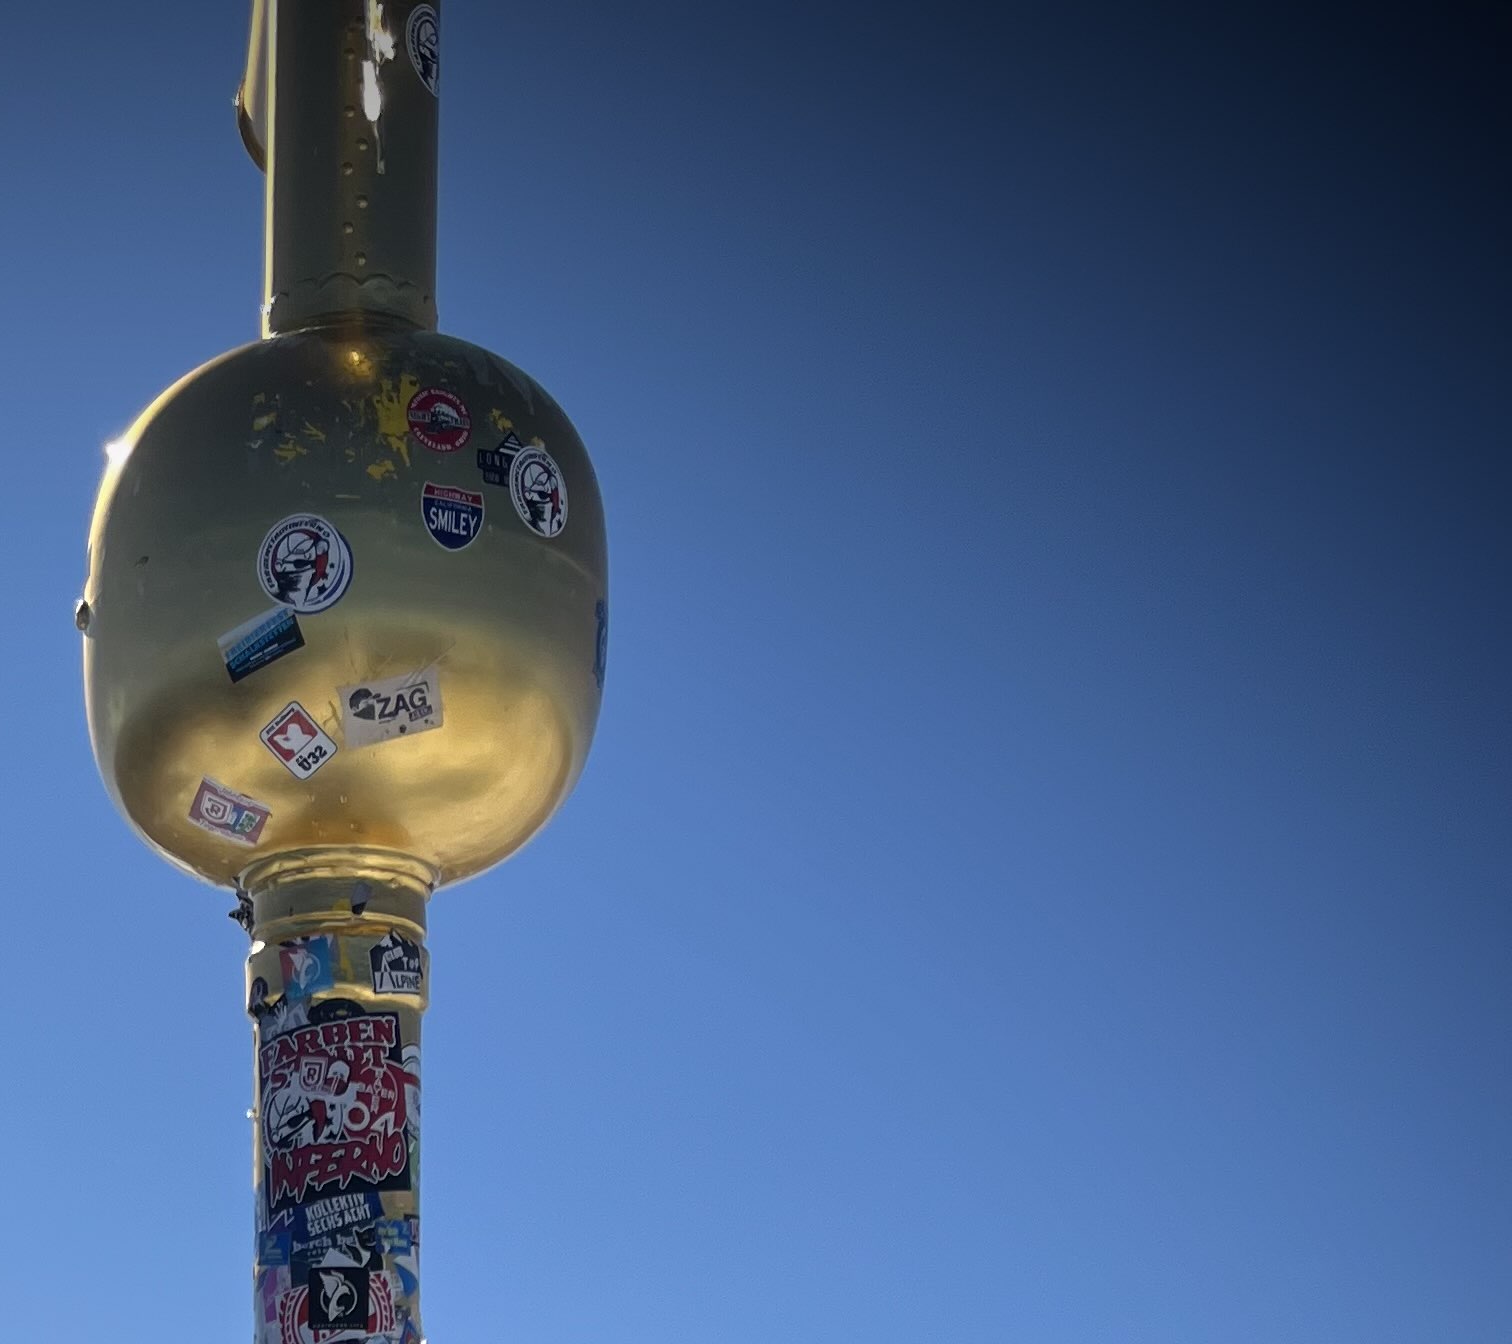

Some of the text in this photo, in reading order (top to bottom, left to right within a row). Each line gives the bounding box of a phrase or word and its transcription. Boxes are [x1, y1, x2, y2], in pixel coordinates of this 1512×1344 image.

[434, 488, 472, 502] HIGHWAY
[429, 506, 478, 537] SMILEY
[376, 687, 428, 720] ZAG
[262, 1016, 398, 1078] FARBEN
[305, 1192, 366, 1219] KOLLEKTIV
[306, 1203, 372, 1237] SECHS ACHT
